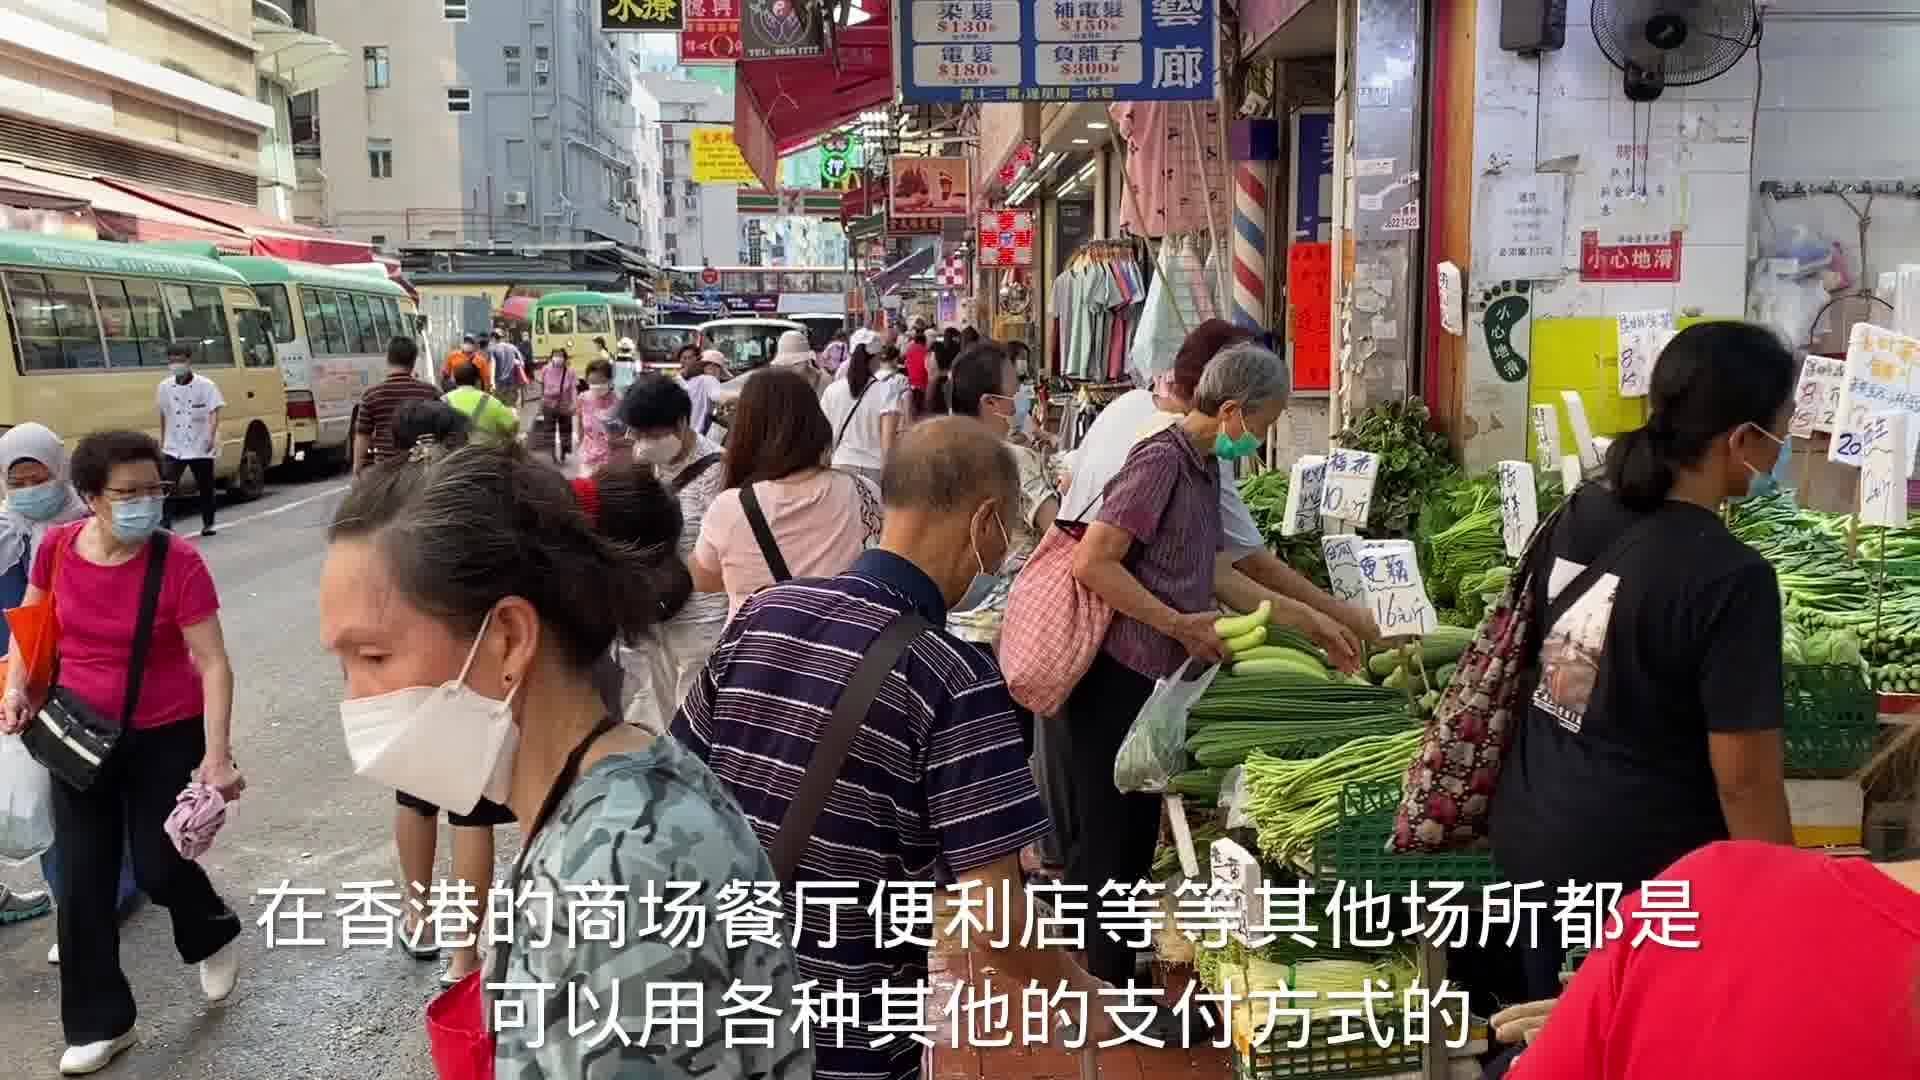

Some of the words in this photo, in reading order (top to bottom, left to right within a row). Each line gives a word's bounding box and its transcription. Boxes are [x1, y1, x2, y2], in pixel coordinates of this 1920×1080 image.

[941, 46, 992, 62] 電髮
[1587, 248, 1673, 270] 小心地滑
[1837, 433, 1862, 456] 20
